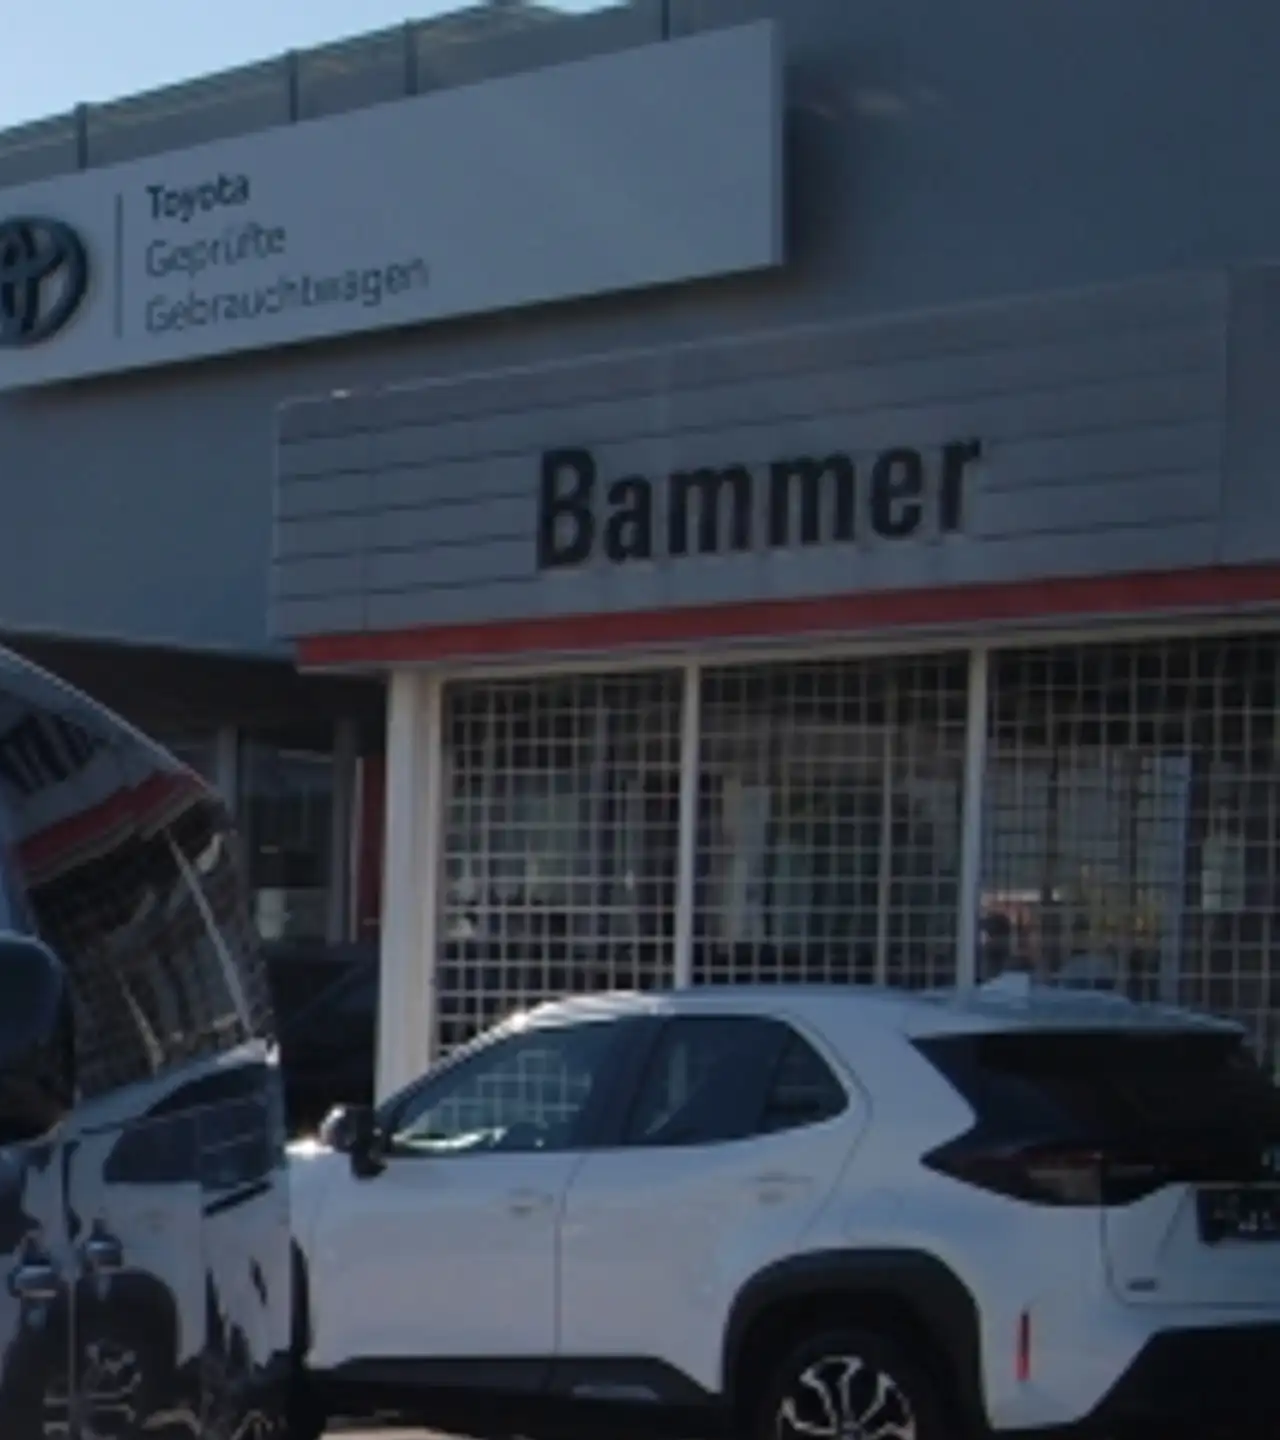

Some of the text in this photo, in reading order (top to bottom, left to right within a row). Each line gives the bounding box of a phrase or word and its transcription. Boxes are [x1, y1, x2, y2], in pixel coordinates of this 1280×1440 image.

[145, 172, 250, 222] Toyota
[145, 222, 287, 278] Geprüfte
[145, 257, 430, 332] Gebrauchtwagen
[535, 437, 981, 570] Bammer
